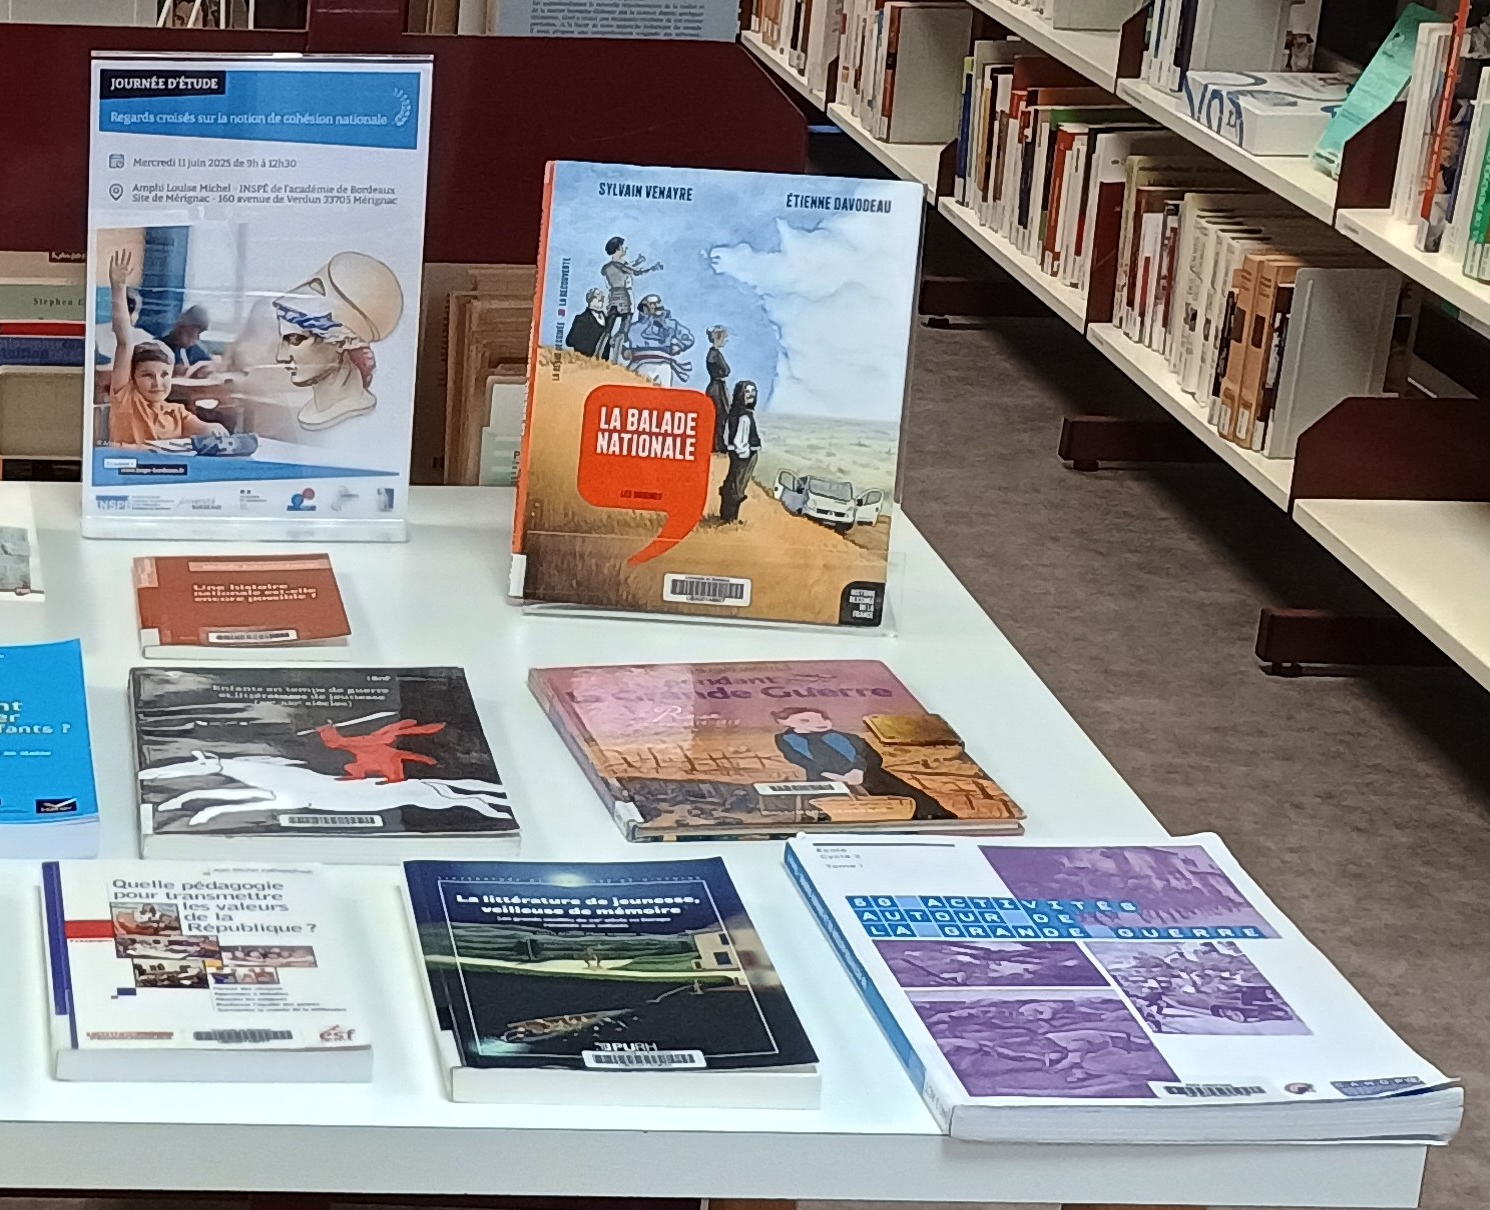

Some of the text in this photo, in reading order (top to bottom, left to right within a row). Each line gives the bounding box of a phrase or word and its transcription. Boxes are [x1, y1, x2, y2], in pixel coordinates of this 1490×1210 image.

[110, 76, 218, 90] JOURNÉE D'ÉTUDE
[110, 112, 387, 125] Regards croisés sur la notion de cohésion nationale
[133, 158, 175, 168] Mercredi
[178, 159, 186, 168] 11
[187, 158, 206, 170] juin
[208, 159, 231, 168] 2025
[233, 158, 245, 168] de
[246, 158, 258, 168] 9h
[268, 158, 297, 168] 12h30
[133, 184, 164, 195] Amphi
[166, 184, 198, 193] Louise
[200, 184, 231, 193] Michel
[271, 185, 282, 194] de
[284, 184, 335, 194] l'académie
[338, 185, 348, 194] de
[350, 185, 395, 194] Bordeaux
[599, 182, 693, 201] SYLVAIN VENAYRE
[133, 194, 150, 203] Site
[152, 194, 163, 203] de
[165, 194, 210, 205] Mérignac
[218, 194, 235, 203] 160
[271, 194, 284, 203] de
[286, 194, 321, 203] Verdun
[353, 194, 398, 205] Mérignac
[787, 193, 891, 213] ÉTIENNE DAVODEAU
[33, 297, 73, 307] Stephen
[600, 407, 697, 436] LA BALADE
[596, 432, 695, 461] NATIONALE
[229, 583, 288, 591] histoire
[286, 687, 326, 695] temps
[760, 685, 892, 700] Guerre
[62, 724, 70, 733] ?
[112, 879, 284, 892] Quelle pédagogie
[114, 891, 283, 900] pour transmettre
[456, 894, 700, 907] La littérature de jeunesse,
[183, 902, 289, 911] les valeurs
[481, 905, 681, 915] veilleuse de mémoire
[184, 912, 233, 922] de la
[862, 911, 1076, 924] AUTOUR DE
[188, 922, 317, 934] République ?
[870, 924, 1260, 938] LA GRANDE GUERRE
